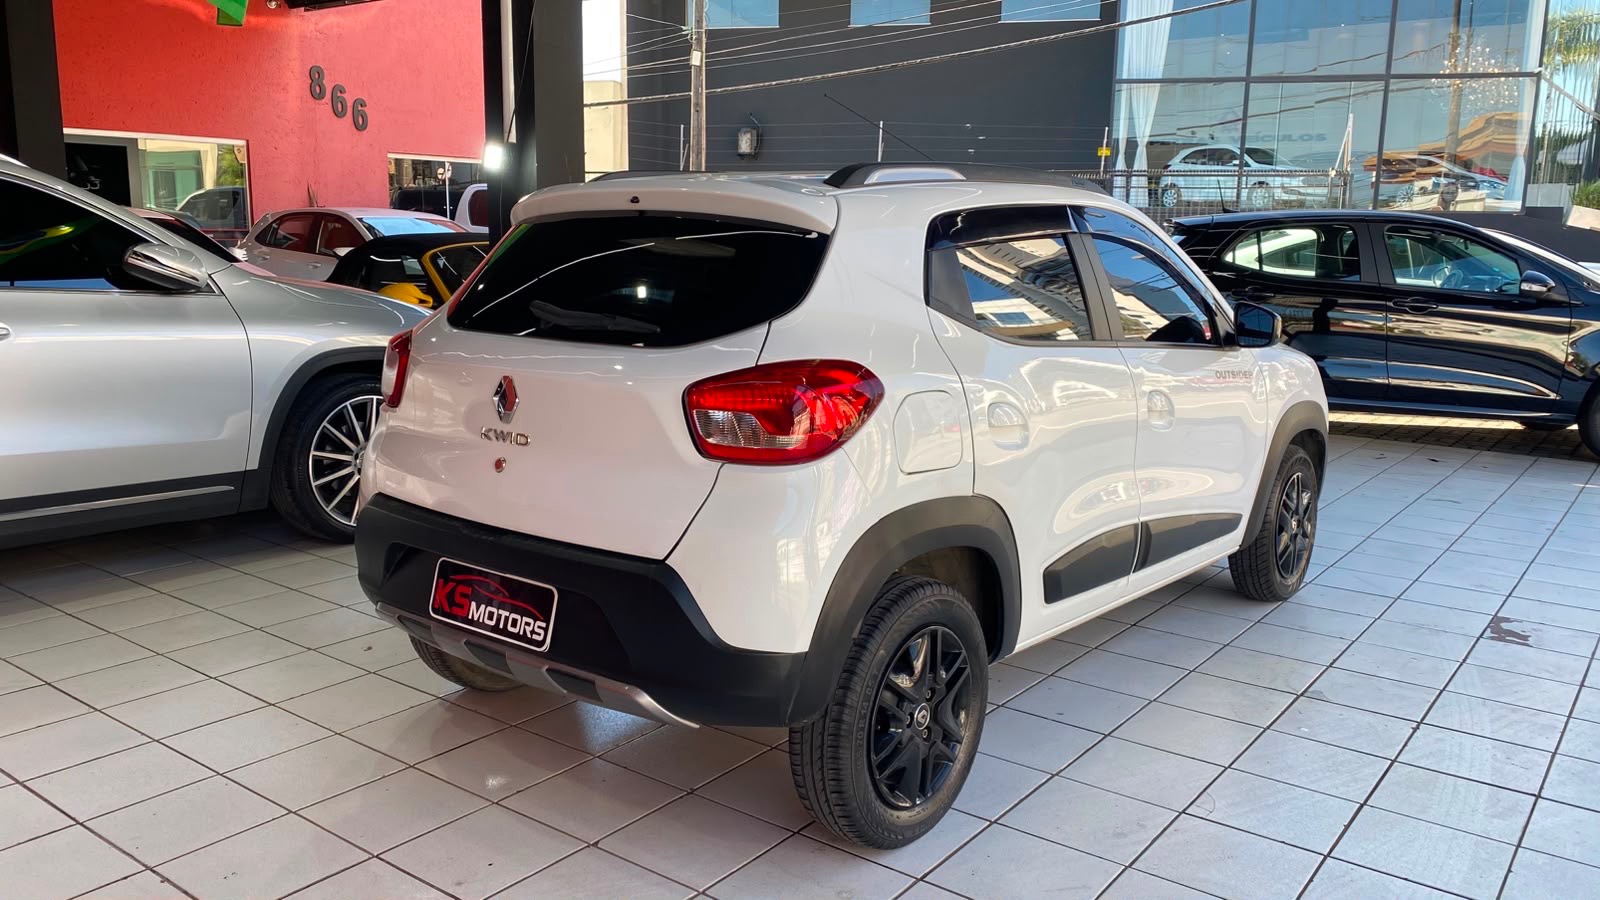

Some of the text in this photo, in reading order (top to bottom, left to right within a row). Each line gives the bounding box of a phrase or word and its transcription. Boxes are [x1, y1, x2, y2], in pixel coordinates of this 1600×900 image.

[308, 65, 369, 132] 866
[480, 426, 531, 447] KWID
[468, 601, 547, 641] MOTORS
